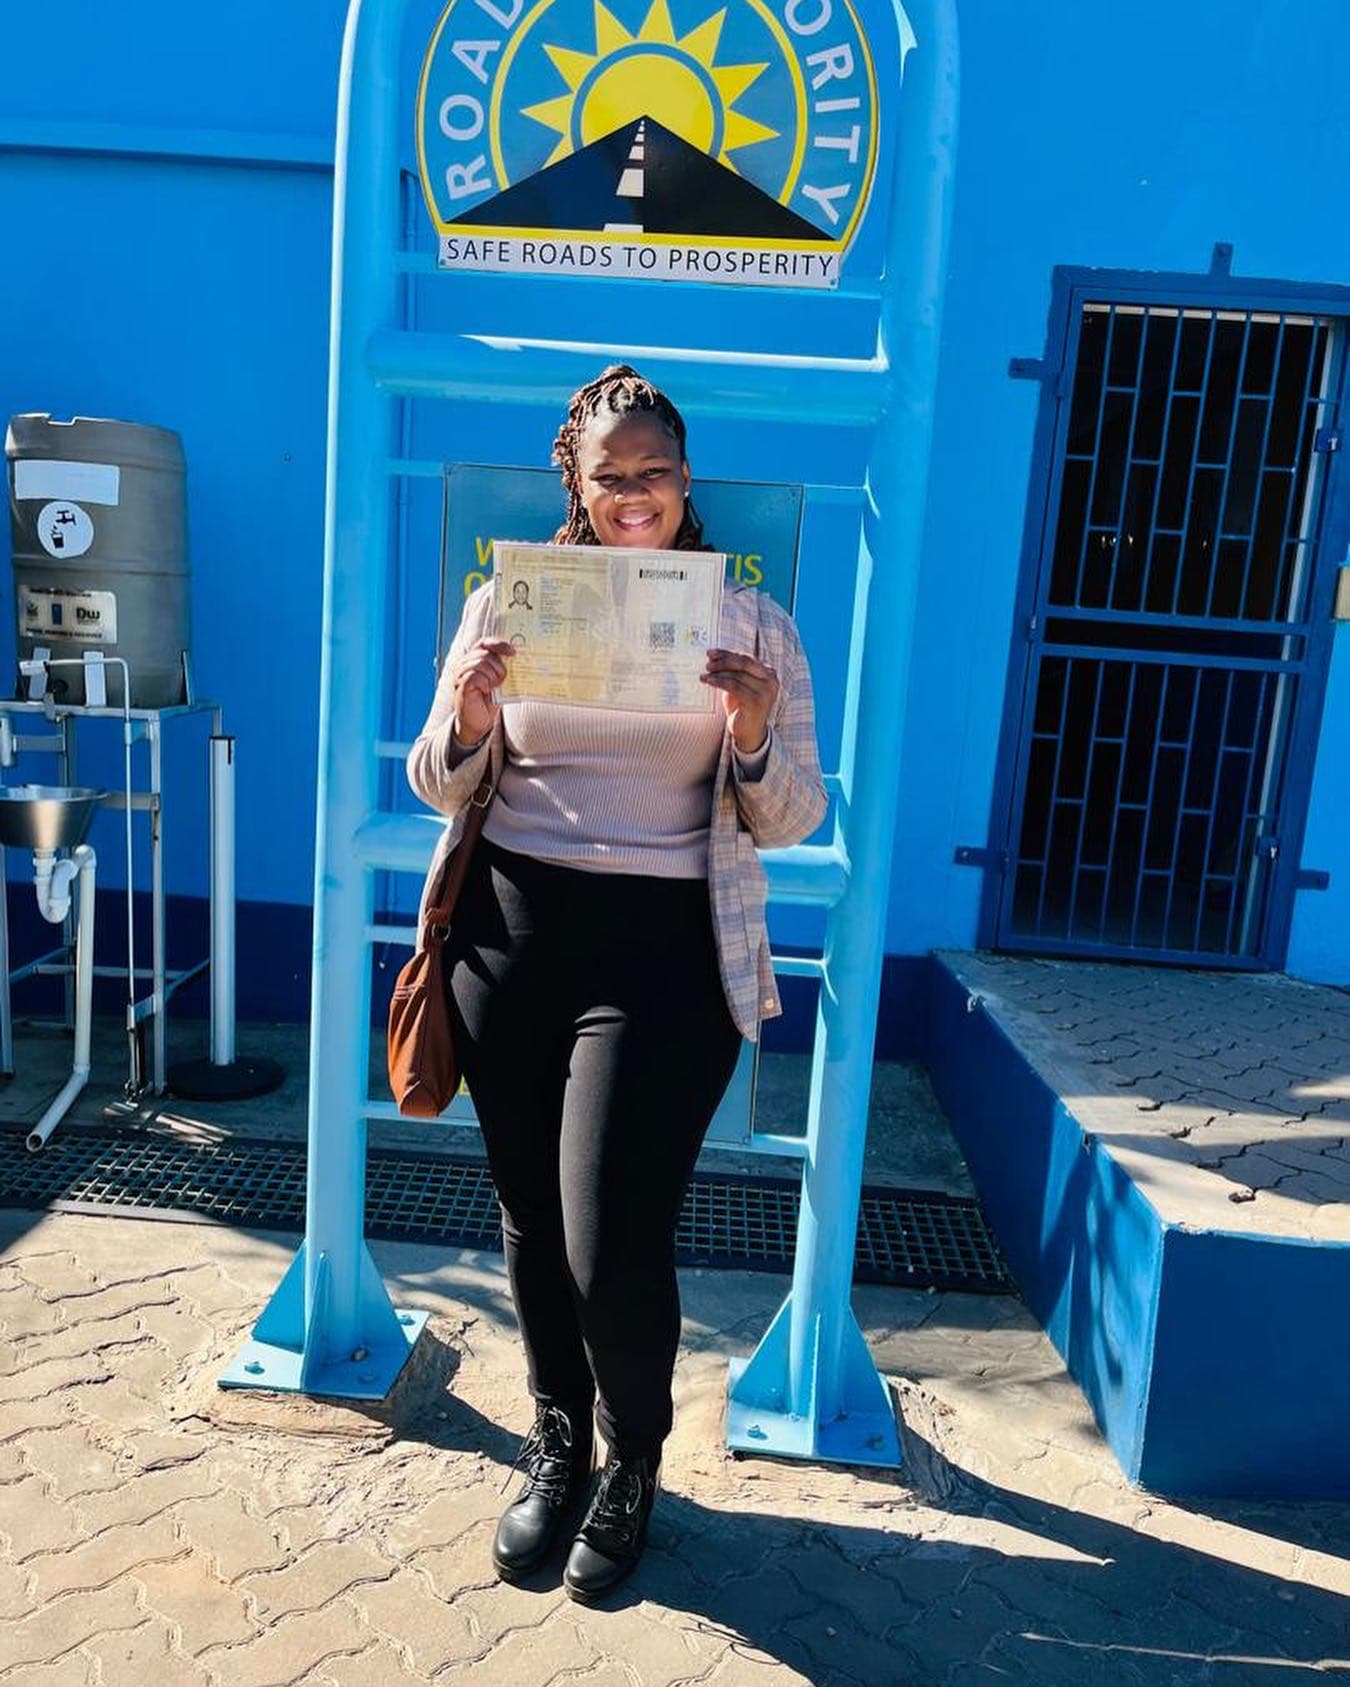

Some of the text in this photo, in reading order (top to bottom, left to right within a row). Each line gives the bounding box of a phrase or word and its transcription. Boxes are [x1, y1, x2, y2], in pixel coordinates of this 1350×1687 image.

[446, 238, 833, 277] SAFE ROADS TO PROSPERITY
